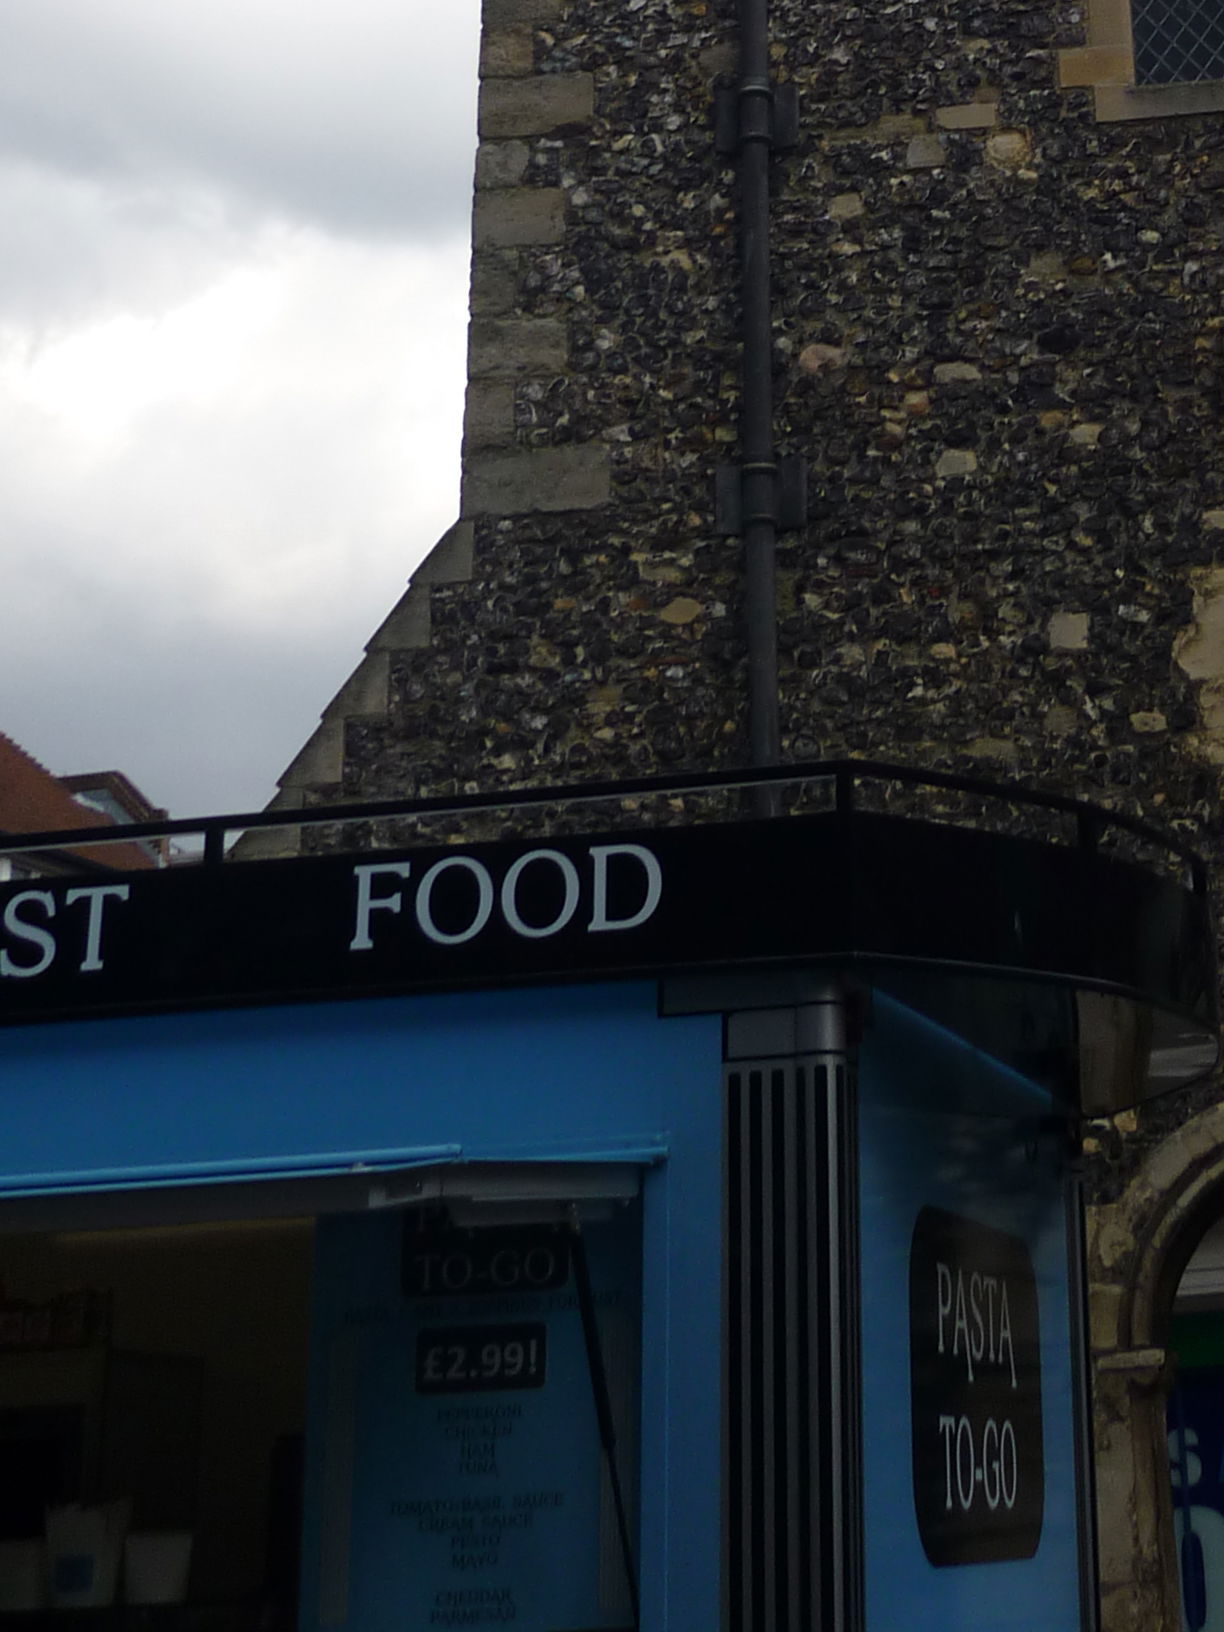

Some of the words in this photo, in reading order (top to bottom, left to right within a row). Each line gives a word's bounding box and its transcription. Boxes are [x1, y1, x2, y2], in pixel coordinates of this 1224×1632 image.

[349, 843, 663, 952] FOOD
[415, 1247, 555, 1292] TO-GO
[422, 1338, 538, 1381] £2.99!
[936, 1261, 1018, 1390] PASTA
[939, 1415, 1018, 1510] TO-GO
